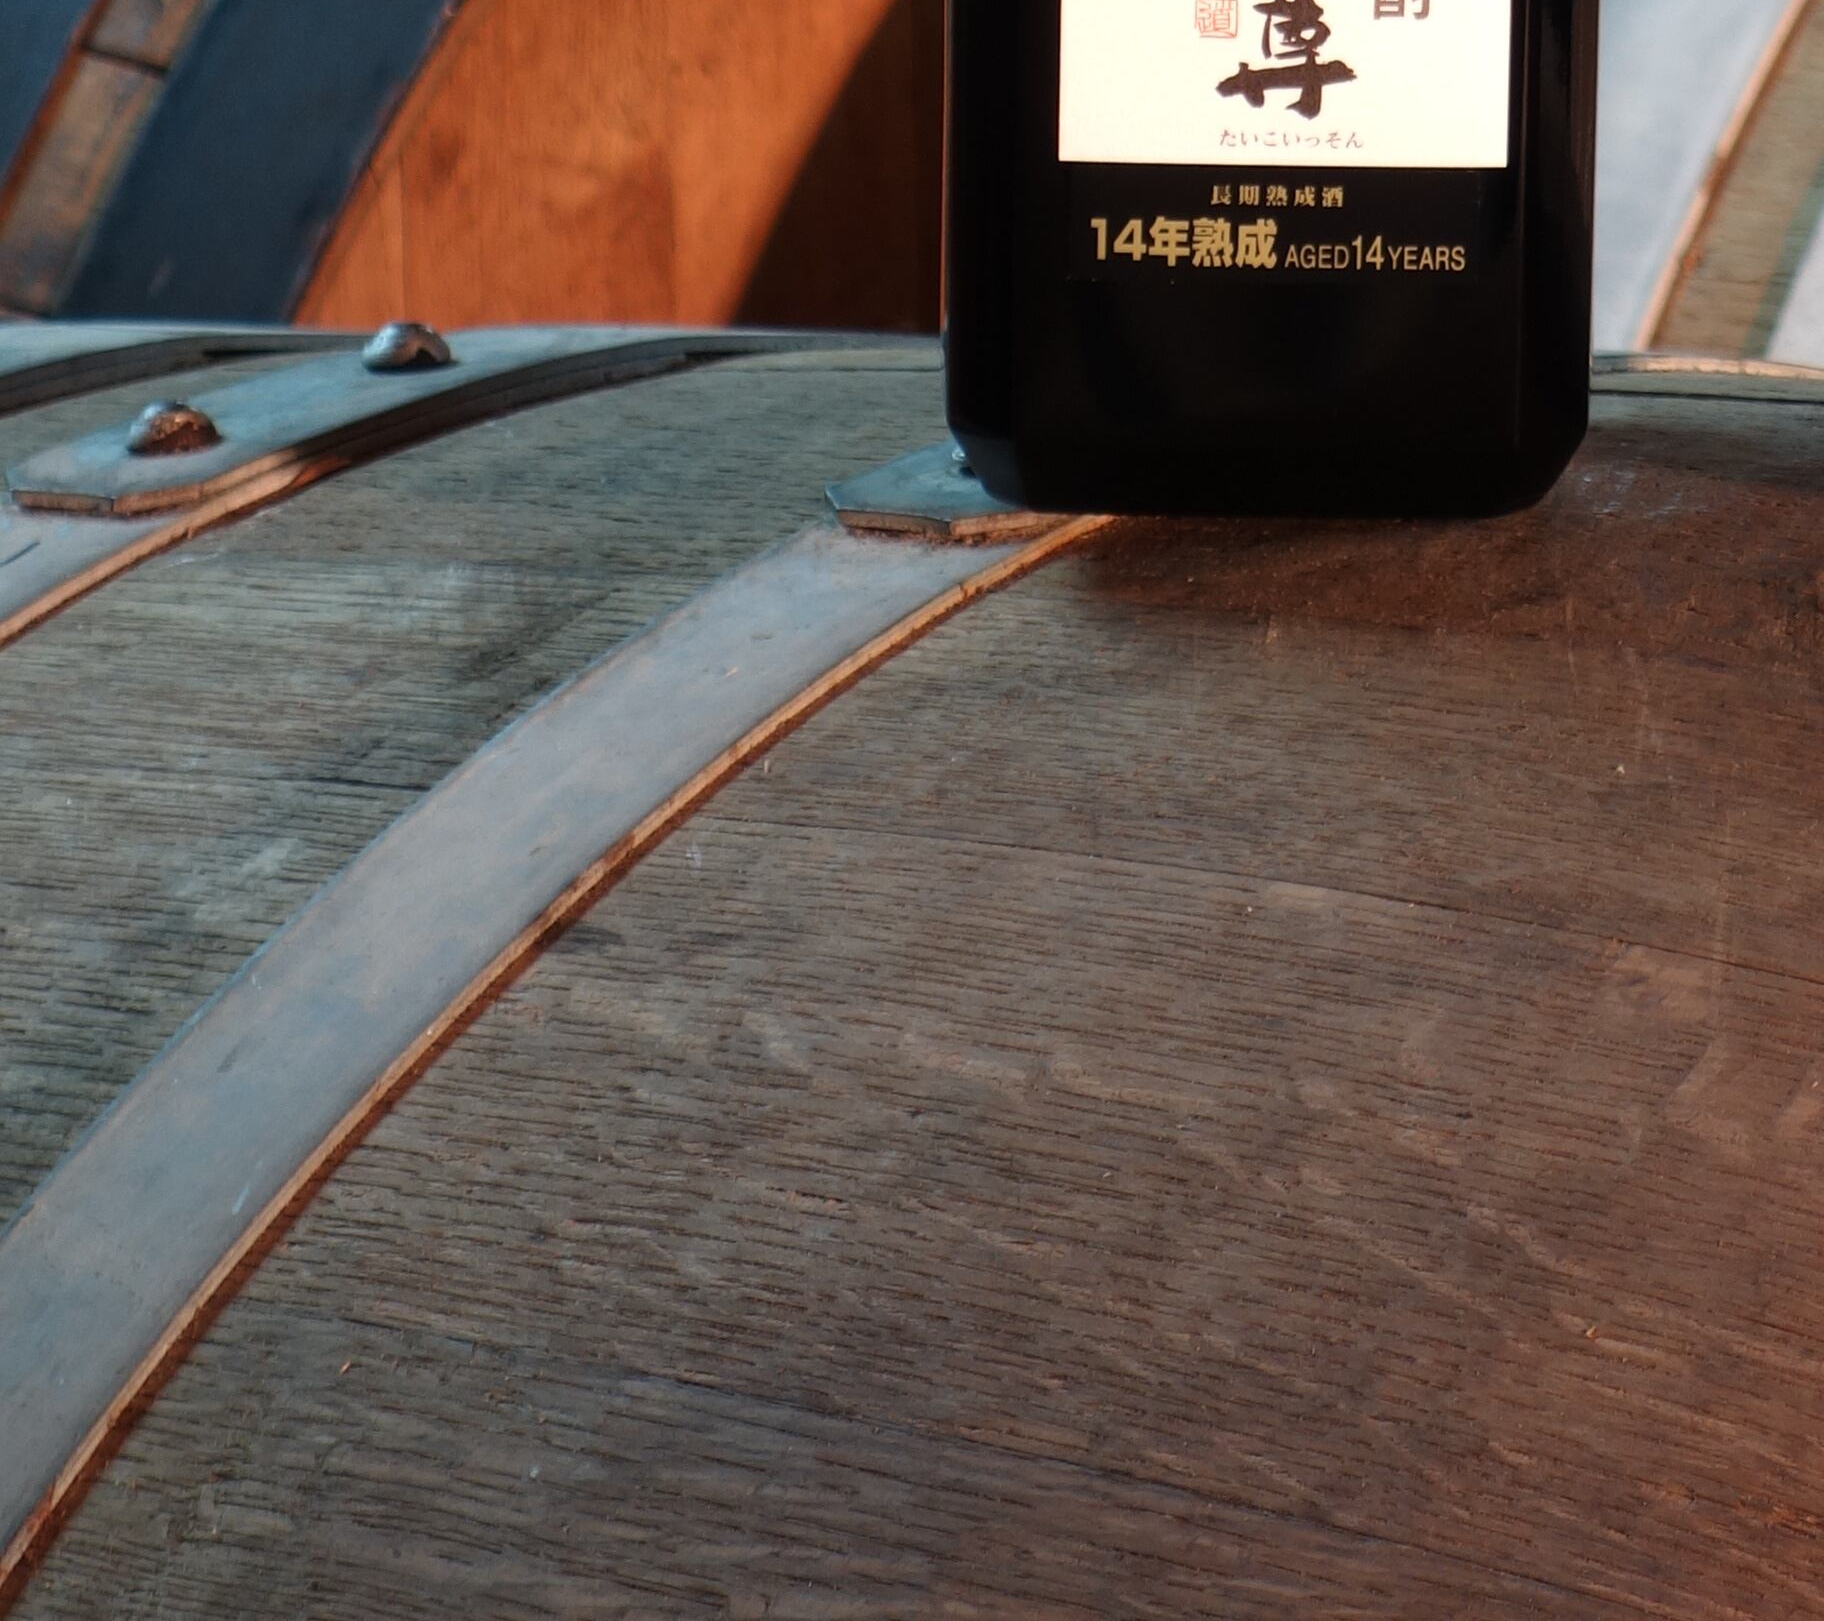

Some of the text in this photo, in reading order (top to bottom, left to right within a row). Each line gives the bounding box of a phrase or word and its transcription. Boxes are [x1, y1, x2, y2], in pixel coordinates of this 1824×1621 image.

[1219, 128, 1364, 149] たいこいっそん
[1210, 184, 1344, 208] 長期熟成酒
[1090, 216, 1278, 269] 14年熟成
